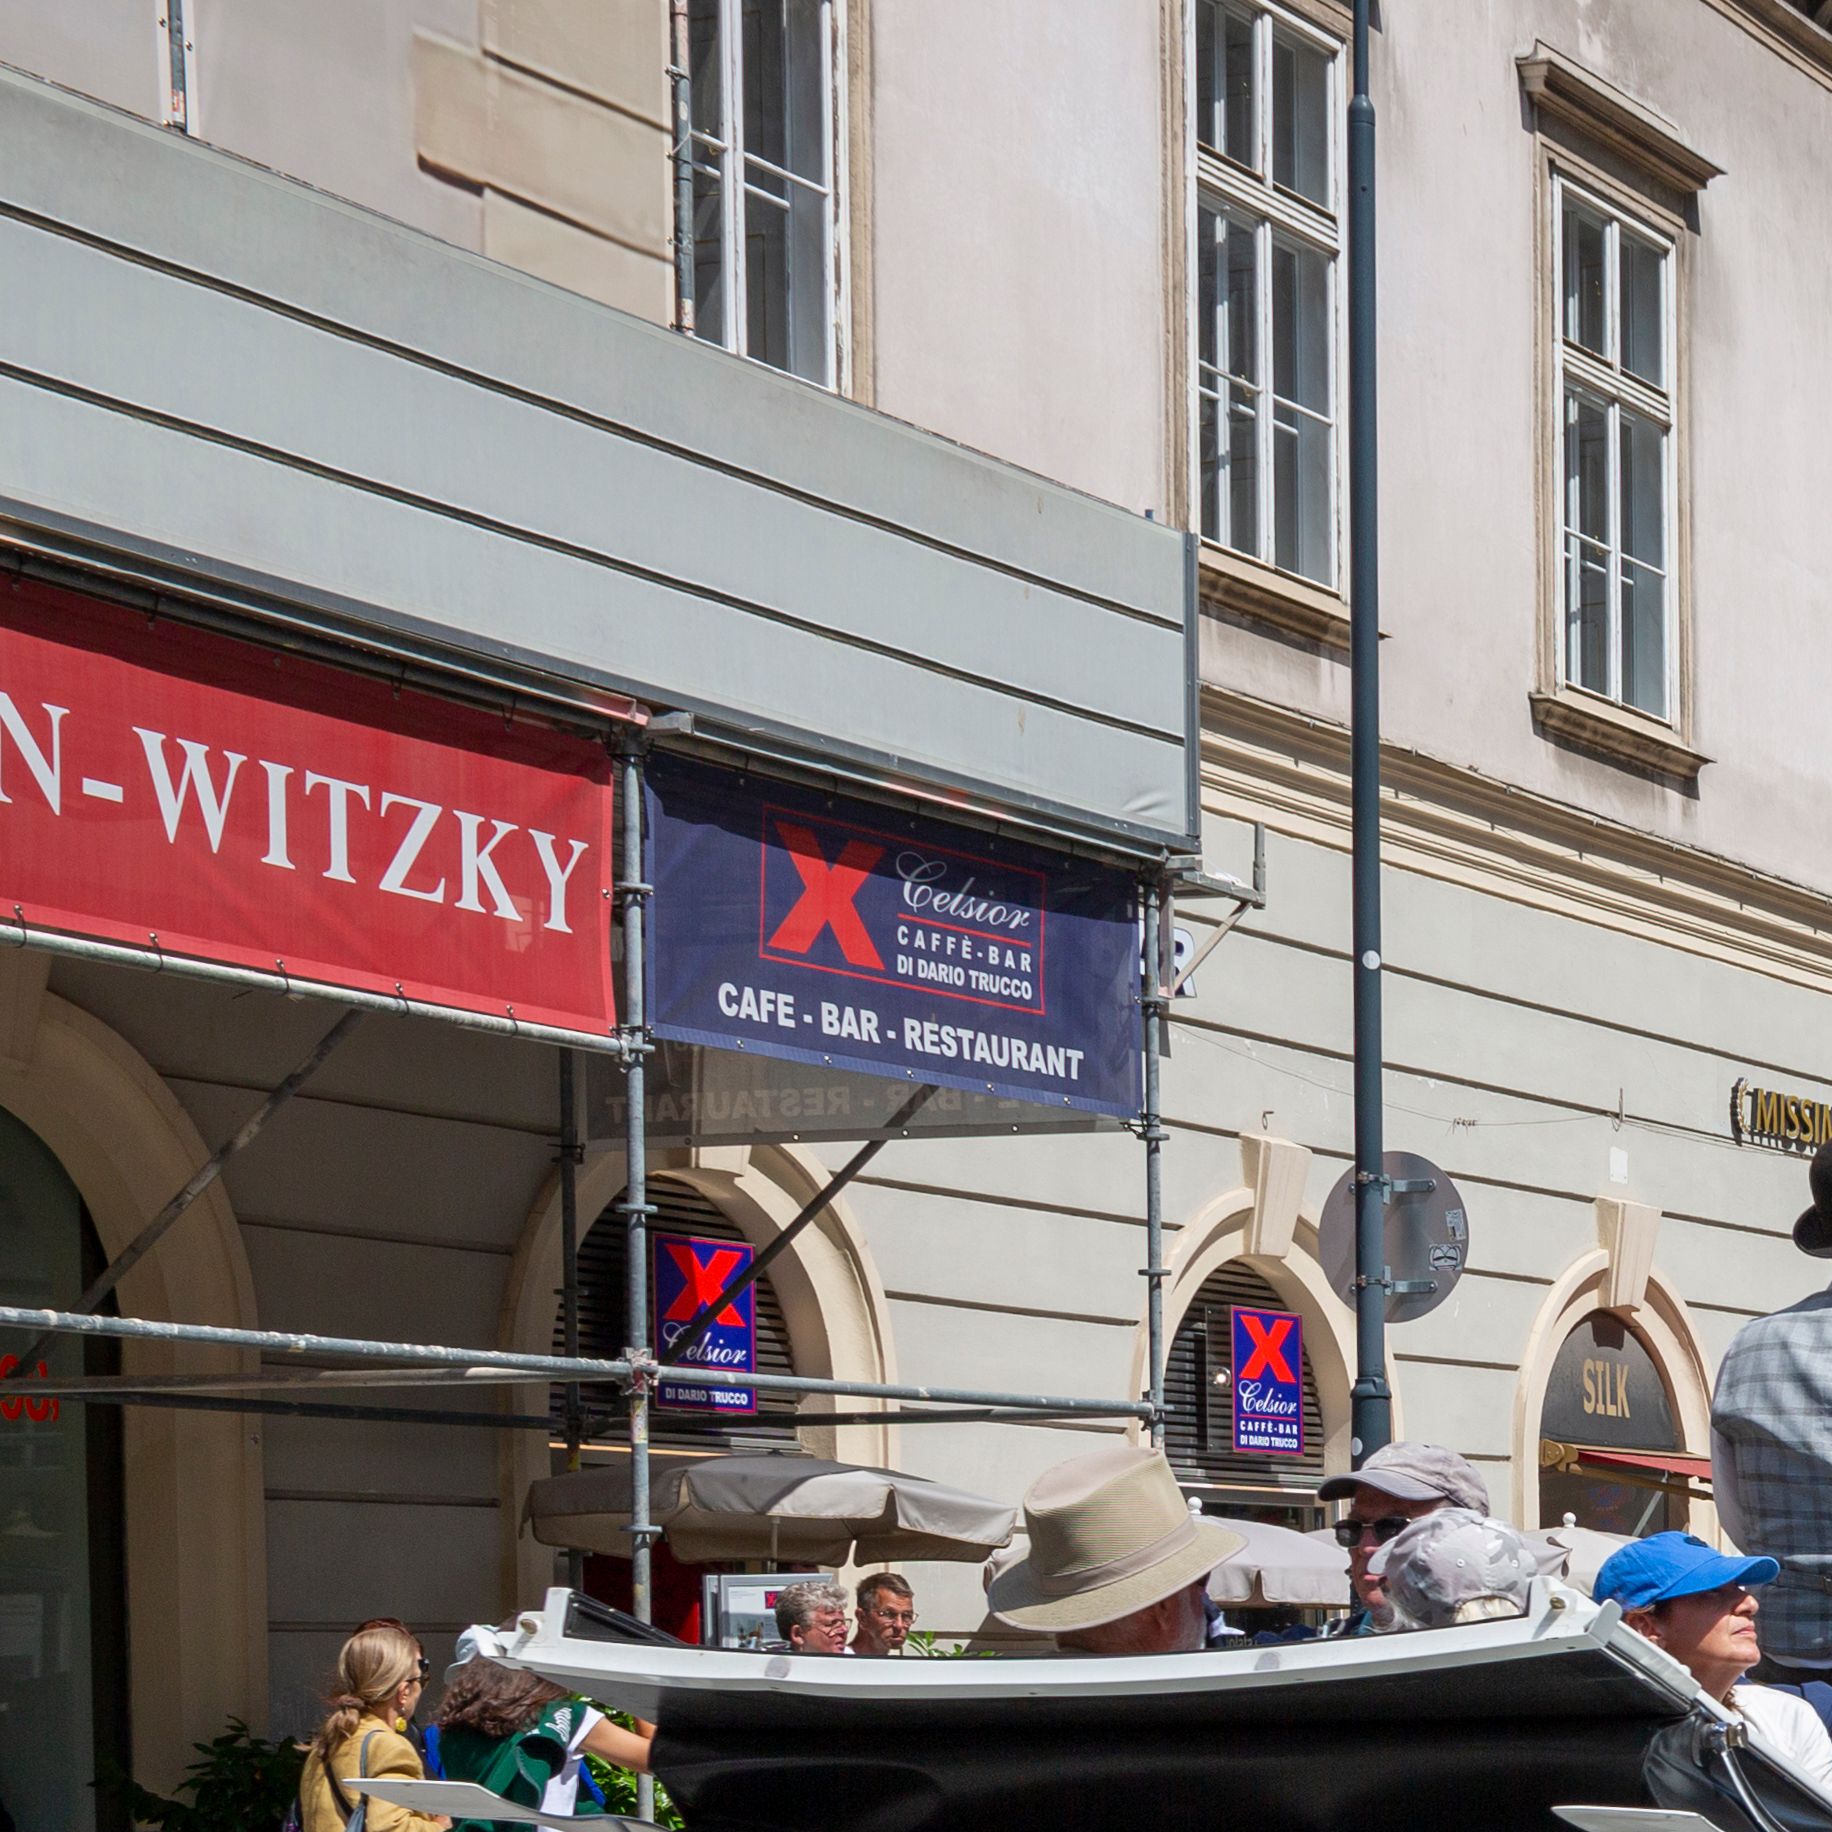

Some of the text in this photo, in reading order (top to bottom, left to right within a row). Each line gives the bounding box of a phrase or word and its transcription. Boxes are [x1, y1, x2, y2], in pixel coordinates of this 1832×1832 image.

[767, 820, 886, 970] X
[895, 851, 1031, 930] Celsior
[897, 924, 1033, 973] CAFFÈ-BAR
[897, 953, 1033, 1000] DI DARIO TRUCCO
[718, 982, 795, 1028] CAFE
[821, 1001, 879, 1044] BAR
[904, 1018, 1085, 1080] RESTAURANT
[1239, 1314, 1297, 1384] X
[665, 1387, 748, 1406] DI DARIO TRUCCO
[1239, 1380, 1297, 1416] Celsior
[1582, 1358, 1631, 1419] SILK
[1240, 1419, 1298, 1435] CAFFÈ-BAR
[1240, 1435, 1248, 1446] DI
[1271, 1437, 1298, 1449] TRUCCO
